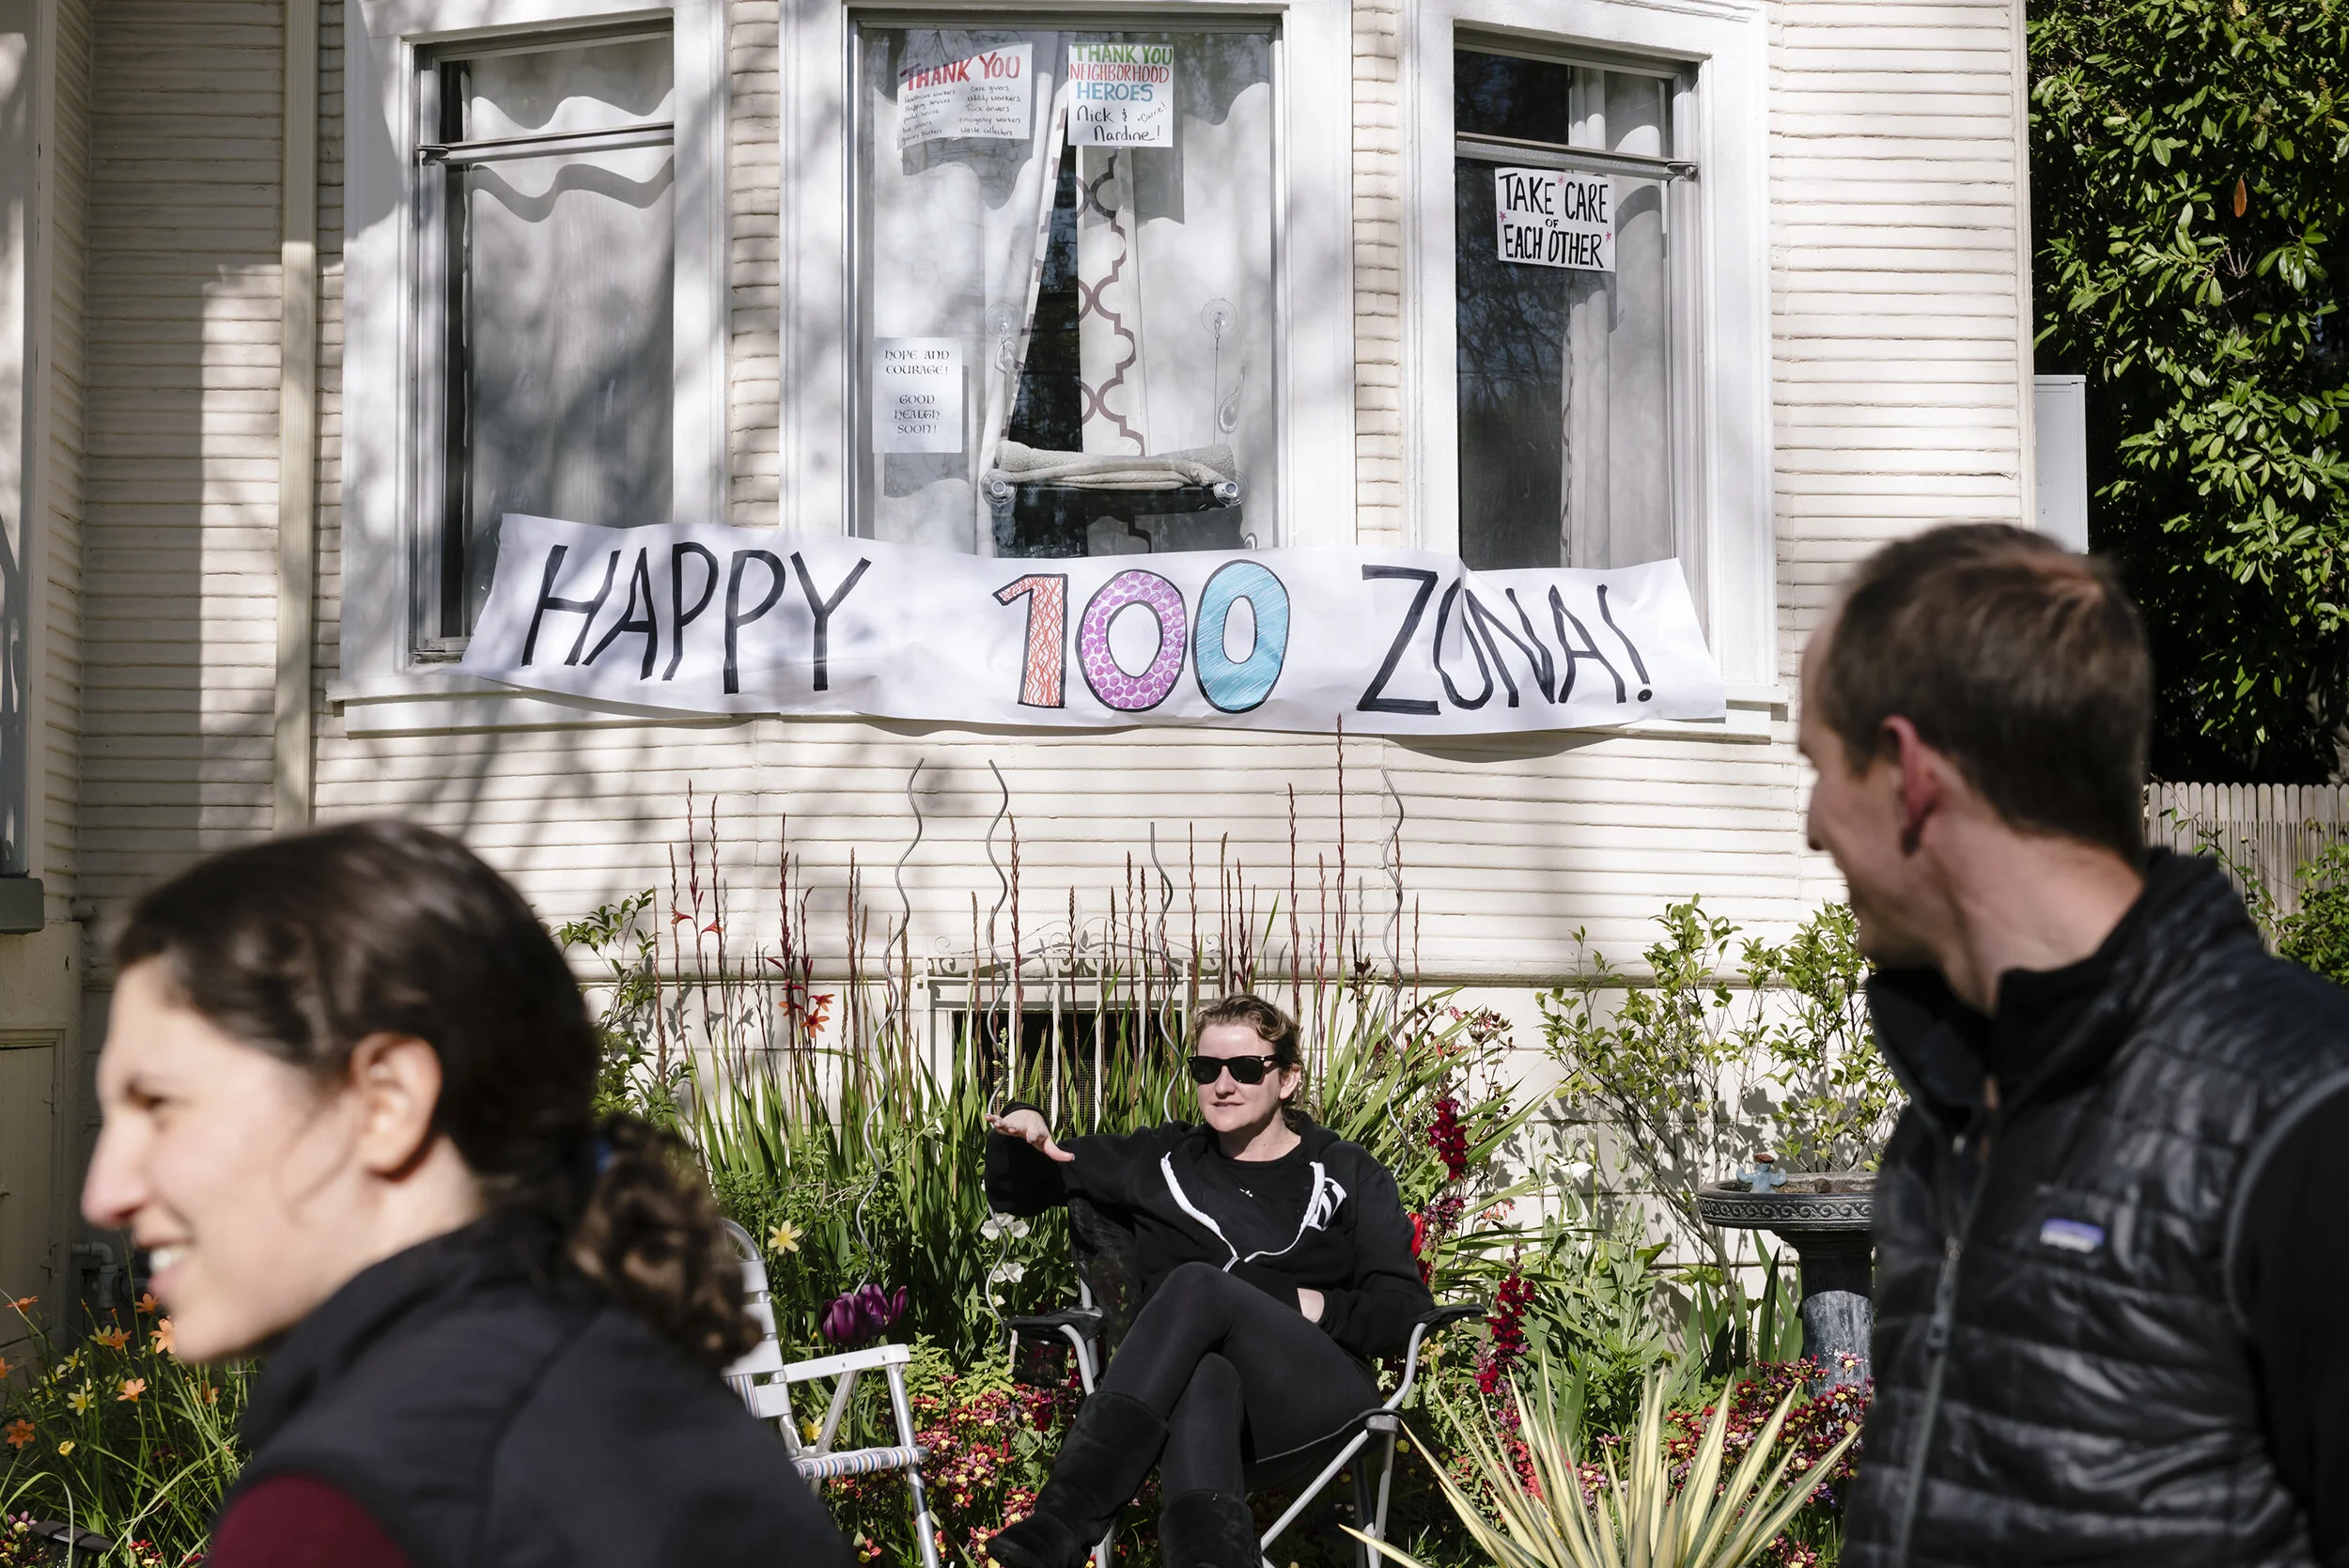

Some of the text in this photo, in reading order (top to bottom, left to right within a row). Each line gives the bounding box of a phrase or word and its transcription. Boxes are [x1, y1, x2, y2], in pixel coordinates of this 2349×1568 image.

[1071, 43, 1174, 66] THANK YOU
[899, 51, 1021, 91] THANK YOU
[1069, 63, 1170, 84] NEIGHBORHOOD
[1076, 81, 1154, 102] HEROES
[1498, 173, 1609, 224] TAKE CARE
[1545, 218, 1559, 228] OF
[1503, 224, 1604, 269] EACH OTHER
[884, 349, 950, 361] HOPE AND
[885, 365, 948, 375] COURAGE!
[898, 395, 935, 405] GOOD
[894, 410, 941, 420] HEALTH
[521, 541, 1654, 715] HAPPY 100 ZONA!
